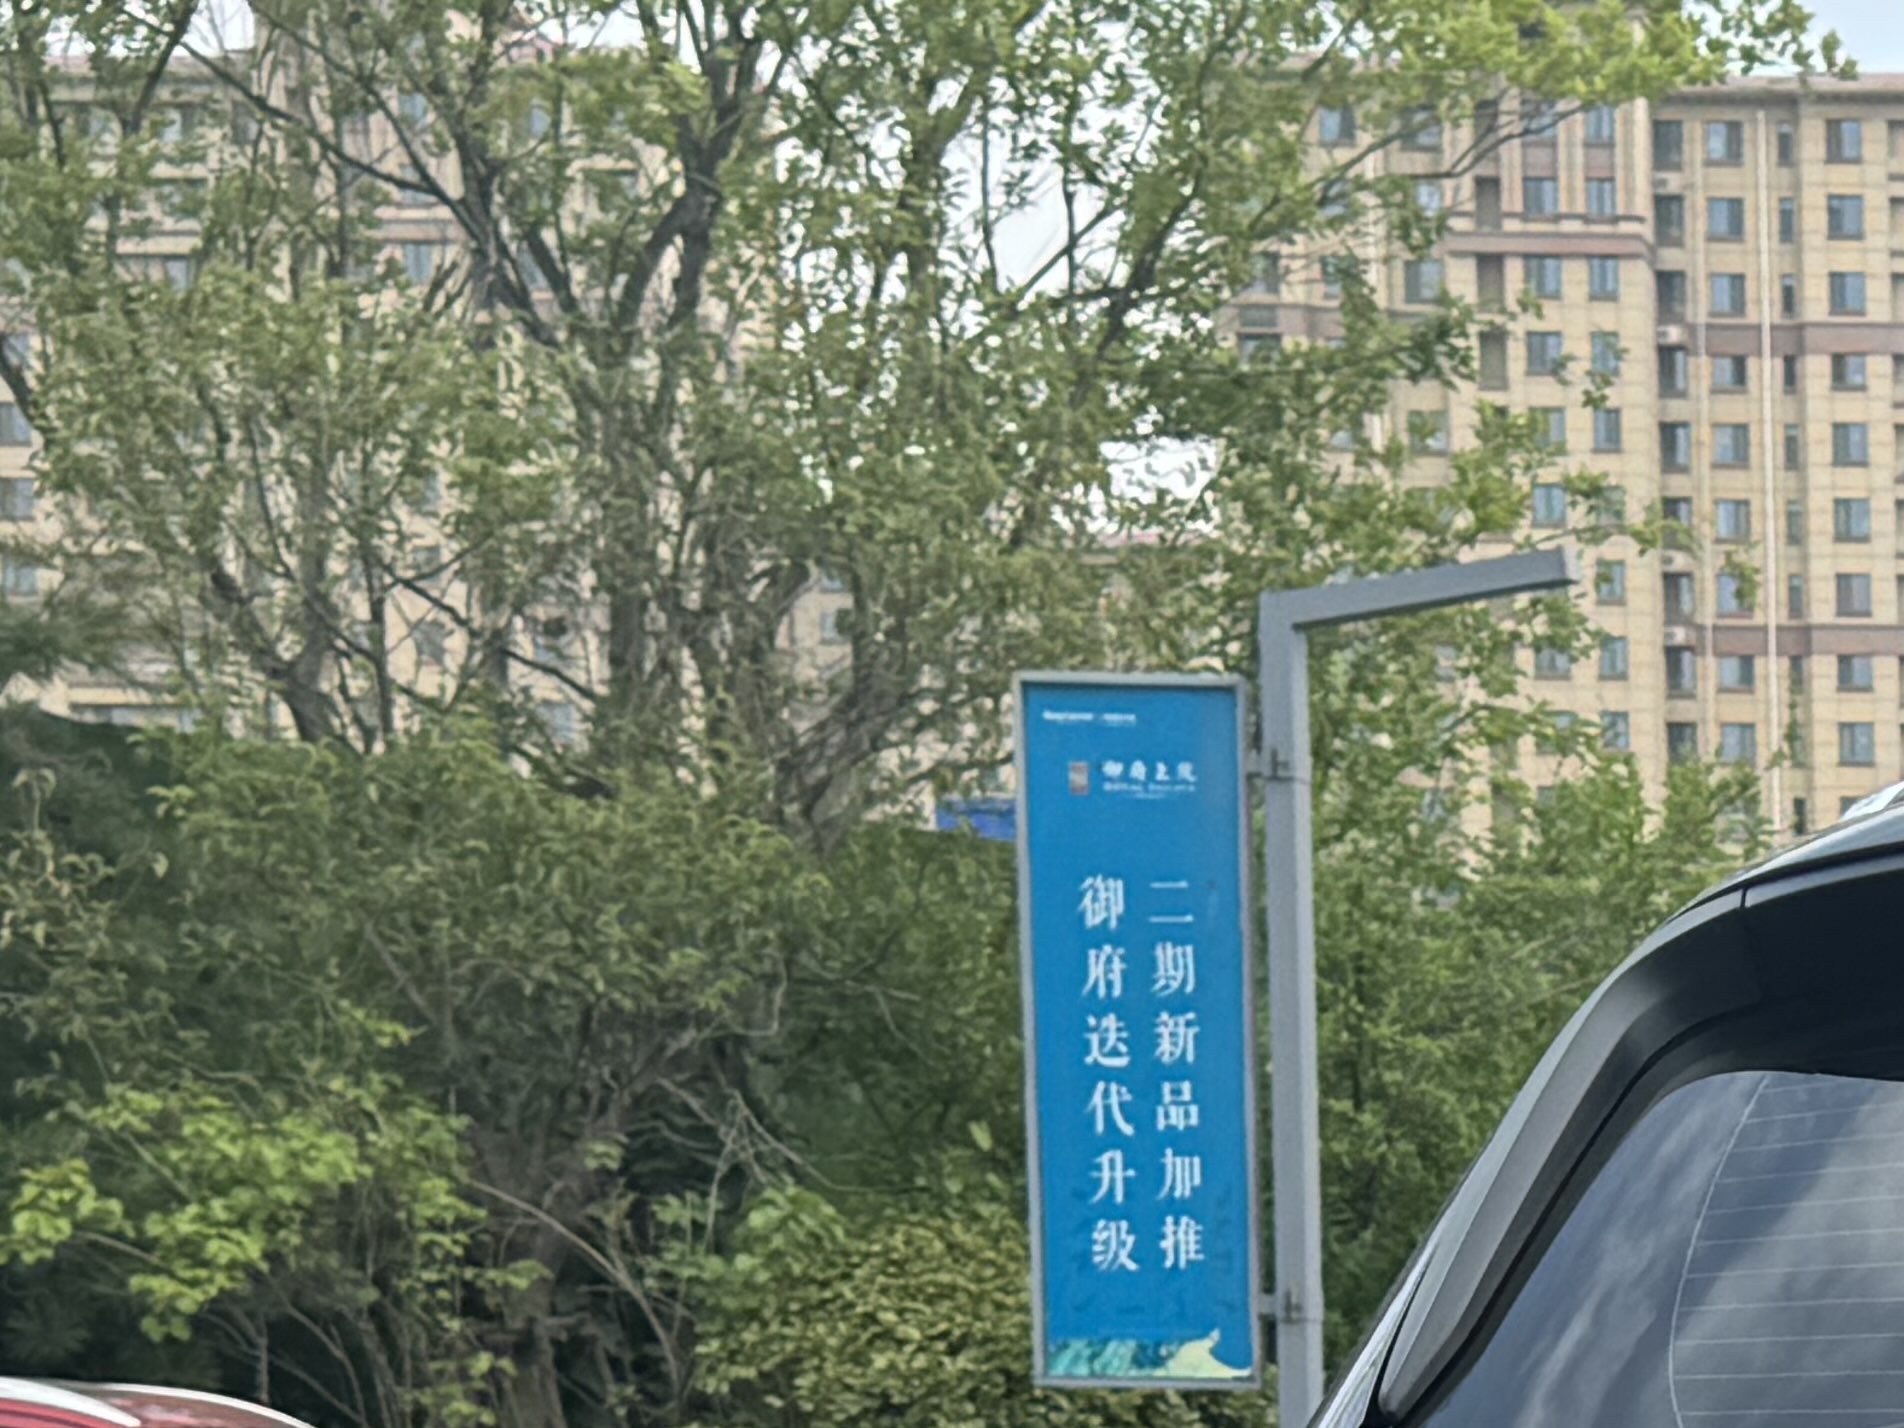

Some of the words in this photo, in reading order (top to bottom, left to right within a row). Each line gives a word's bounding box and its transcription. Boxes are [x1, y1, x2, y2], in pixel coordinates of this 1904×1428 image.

[1077, 873, 1139, 1272] 御府迭代升级
[1148, 880, 1205, 1270] 二期新品加推
